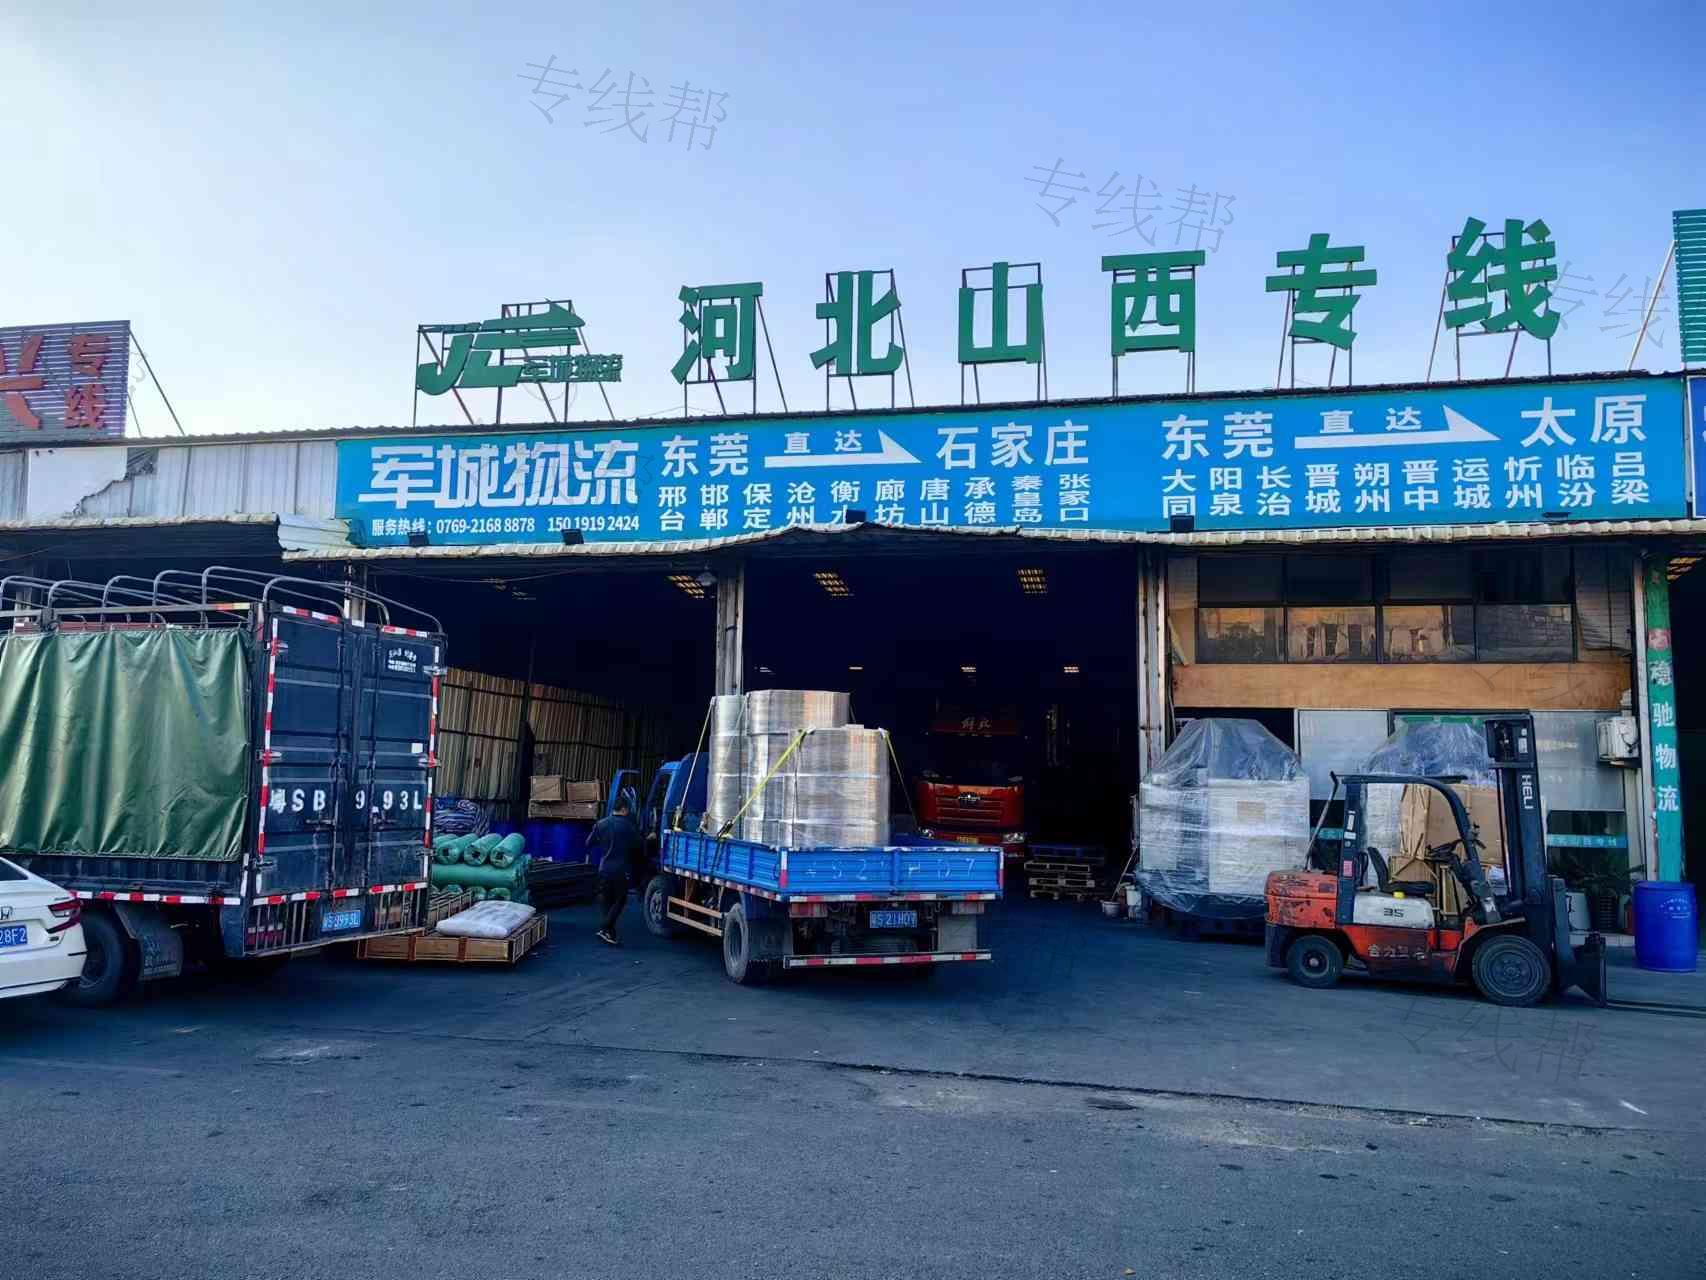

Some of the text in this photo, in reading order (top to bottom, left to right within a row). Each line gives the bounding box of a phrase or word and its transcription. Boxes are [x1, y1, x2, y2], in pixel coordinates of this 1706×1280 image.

[671, 217, 1561, 385] 河北山西专线
[660, 433, 749, 478] 东莞
[783, 430, 863, 455] 直达
[936, 420, 1089, 470] 石家庄
[1161, 411, 1274, 460] 东莞
[1320, 407, 1423, 434] 直达
[1519, 394, 1648, 447] 太原
[358, 440, 640, 510] 军城物流
[658, 486, 687, 531] 邢台
[700, 485, 729, 530] 邯郸
[743, 483, 772, 529] 保定
[787, 482, 816, 527] 沧州
[876, 479, 906, 526] 廊坊
[920, 477, 950, 525] 唐山
[964, 476, 996, 524] 承德
[1012, 475, 1043, 523] 秦皇岛
[1059, 473, 1090, 523] 张家口
[1162, 452, 1650, 519] 大同 阳泉 长治 晋城 朔州 晋中 运城 忻州 临汾 吕梁
[436, 518, 500, 534] 0769-2168
[504, 517, 535, 532] 8878
[574, 516, 605, 530] 1919
[607, 515, 640, 531] 2424
[1521, 774, 1534, 809] HELI
